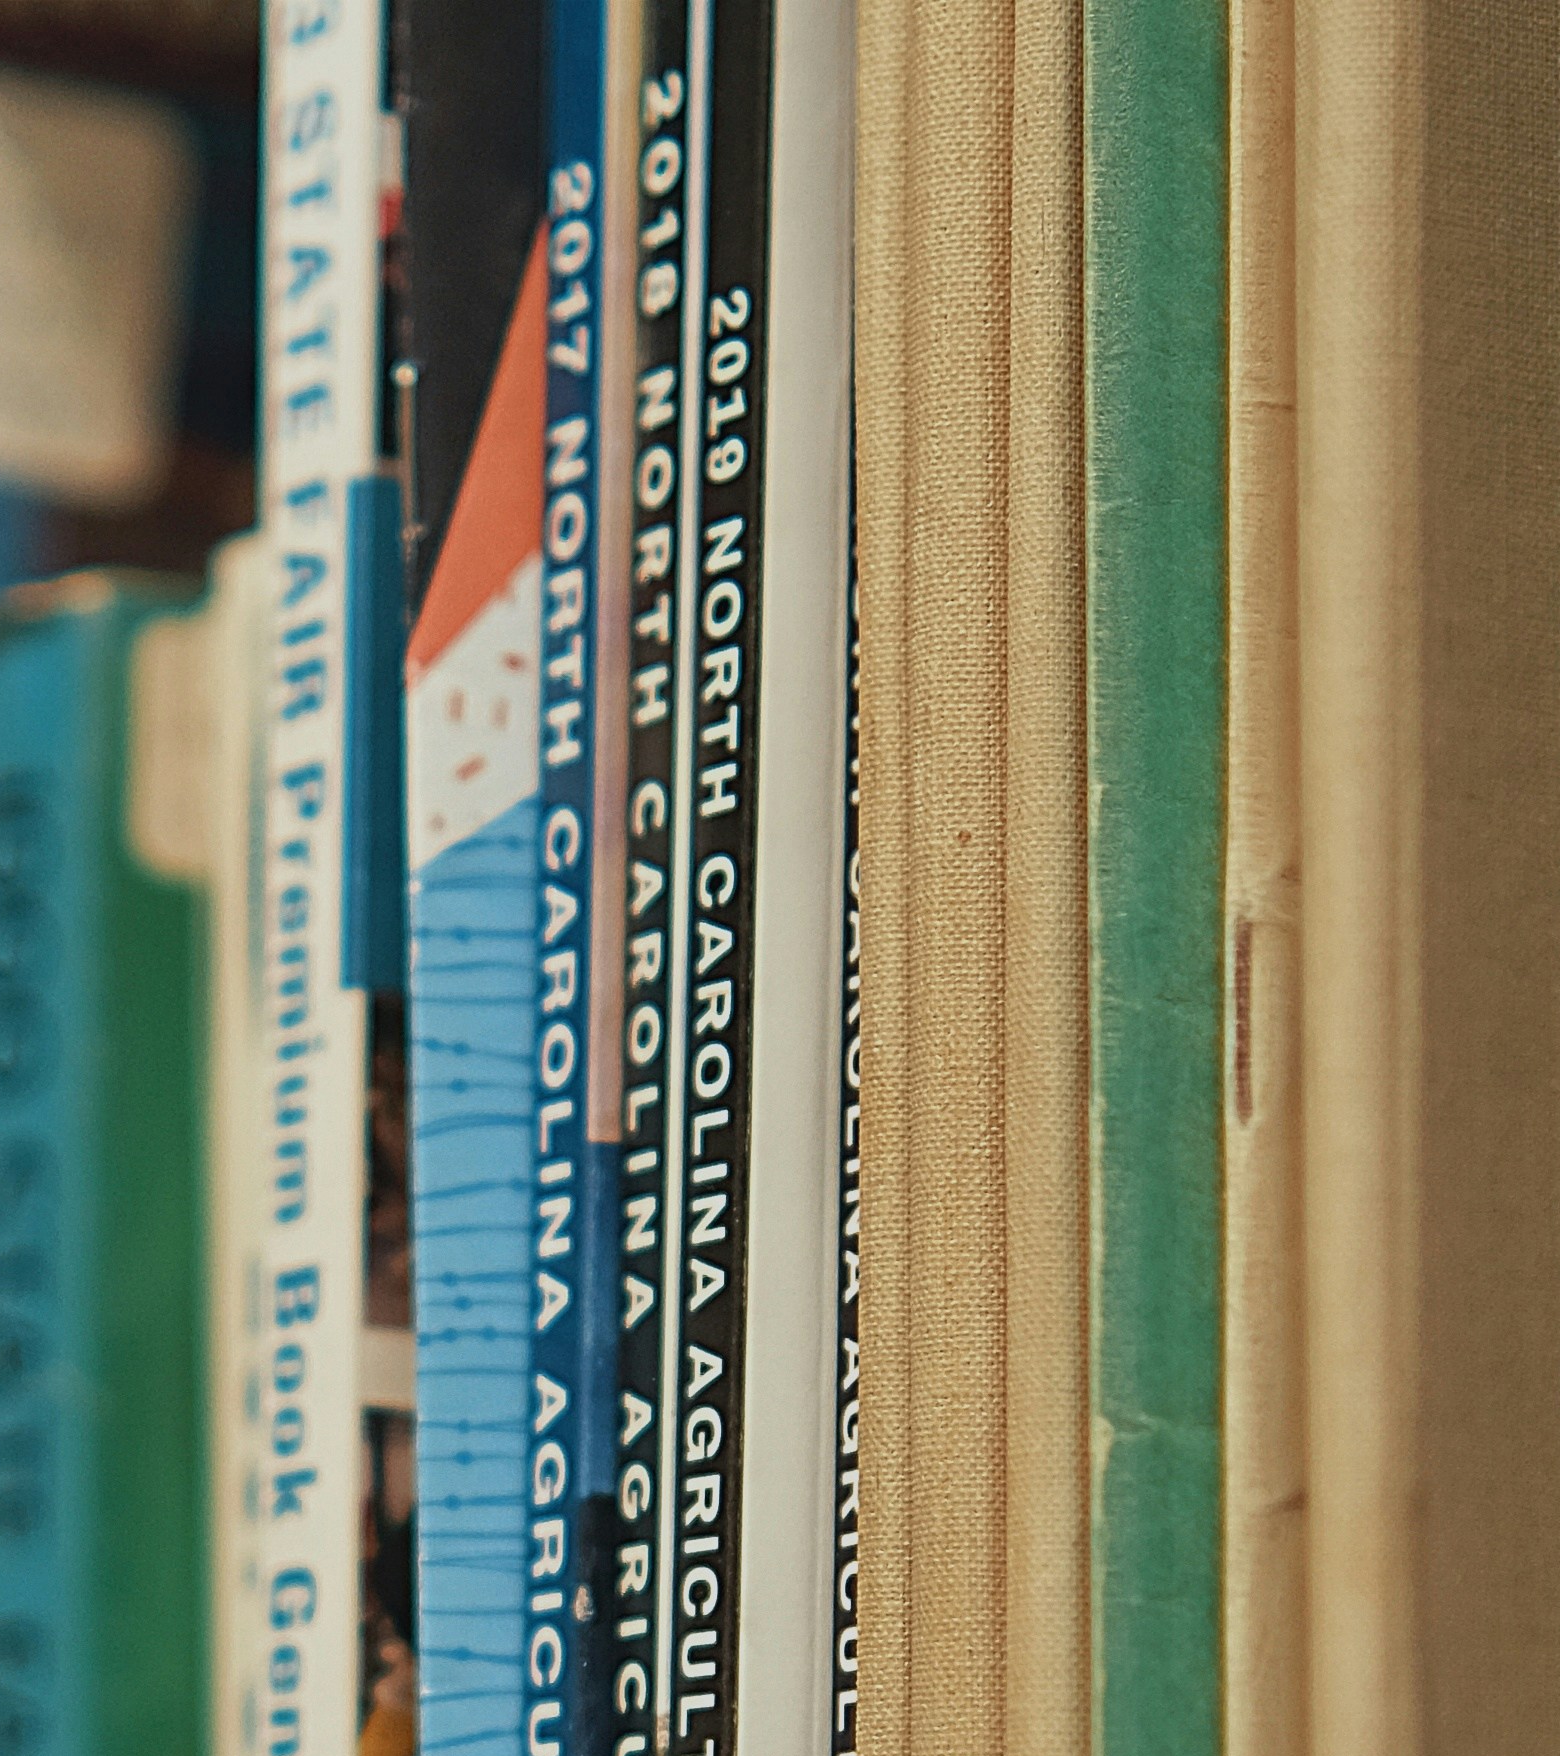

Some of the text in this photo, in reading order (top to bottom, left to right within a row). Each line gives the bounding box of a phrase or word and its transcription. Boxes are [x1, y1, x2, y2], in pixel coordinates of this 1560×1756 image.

[284, 90, 334, 437] STATE
[550, 161, 594, 373] 2017
[640, 71, 683, 316] 2018
[632, 367, 676, 727] NORTH
[706, 288, 749, 484] 2019
[279, 480, 330, 721] FAIR
[544, 417, 589, 767] NORTH
[698, 516, 745, 819] NORTH
[273, 764, 326, 1224] Premium
[534, 806, 581, 1332] CAROLINA
[623, 780, 667, 1331] CAROLINA
[688, 854, 737, 1314] CAROLINA
[269, 1263, 323, 1518] Book
